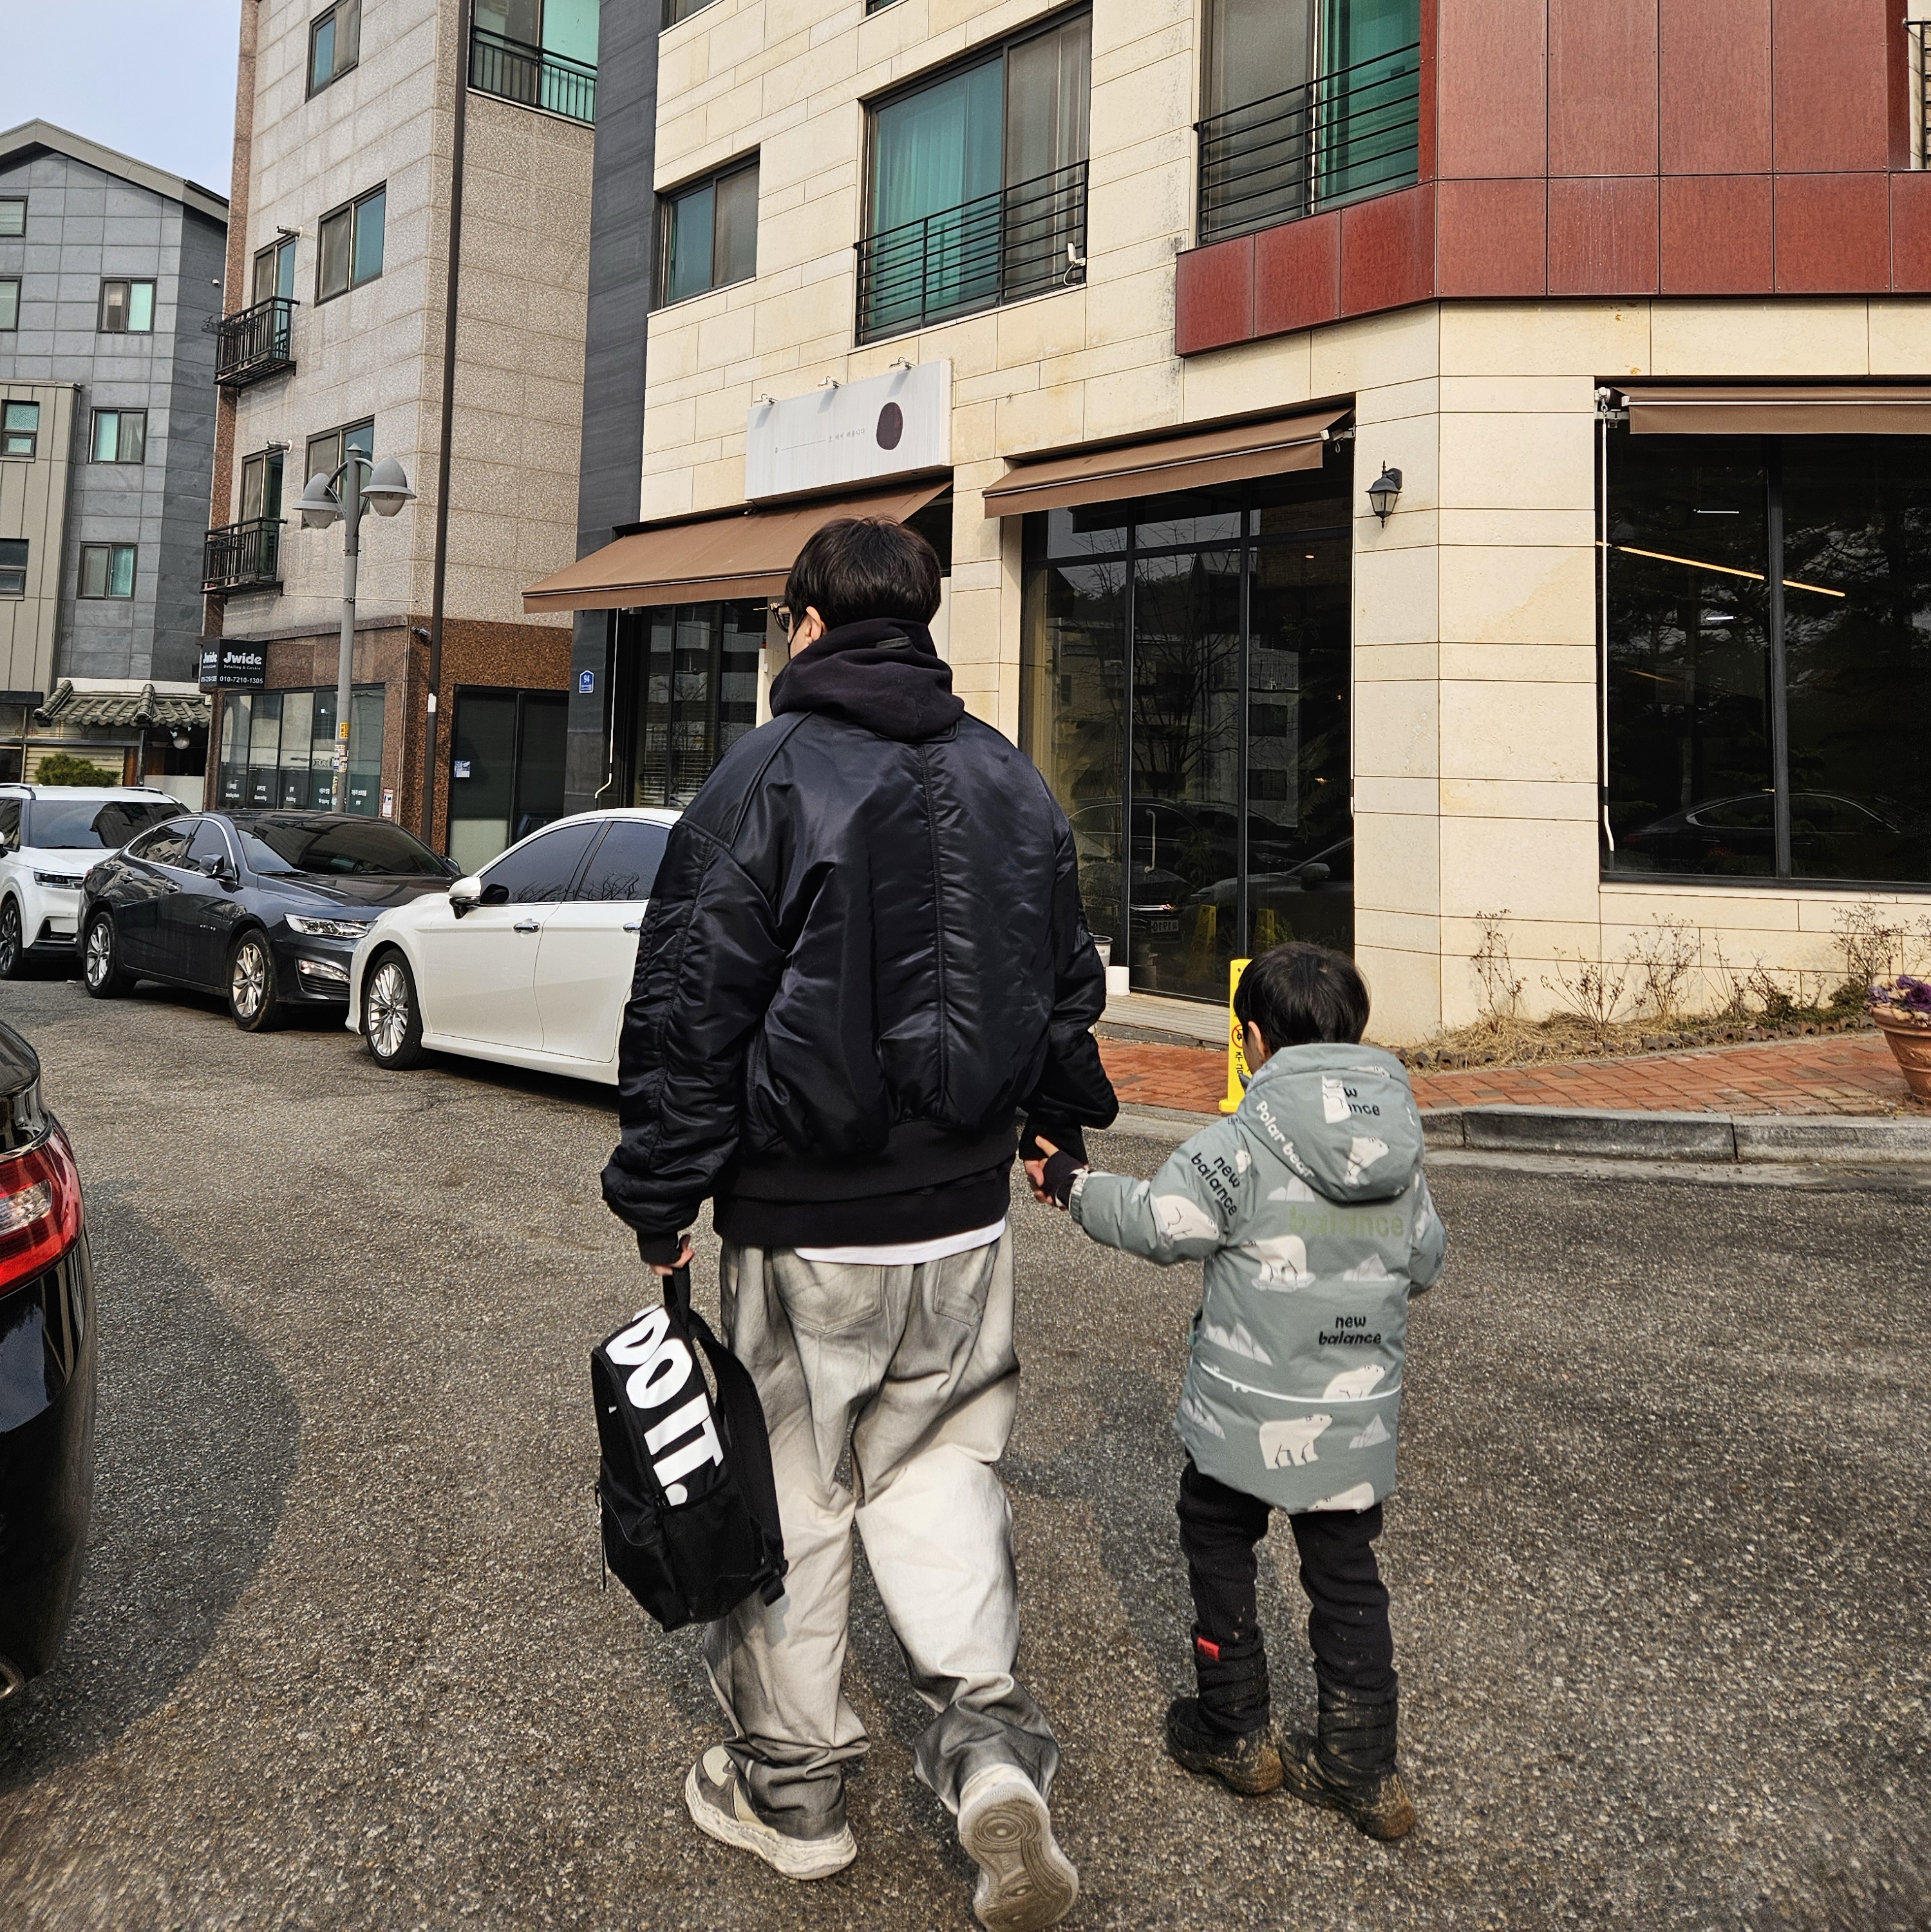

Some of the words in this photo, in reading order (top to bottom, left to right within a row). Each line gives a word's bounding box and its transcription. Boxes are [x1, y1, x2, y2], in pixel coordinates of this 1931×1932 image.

[223, 652, 262, 665] Jwide
[220, 676, 263, 684] 010-7210-1305
[1256, 1100, 1286, 1142] Polar
[1283, 1141, 1314, 1178] bear
[1191, 1152, 1238, 1217] balance
[1213, 1157, 1240, 1189] new
[1290, 1204, 1404, 1238] balance
[1335, 1316, 1366, 1329] new
[1319, 1331, 1381, 1345] balance
